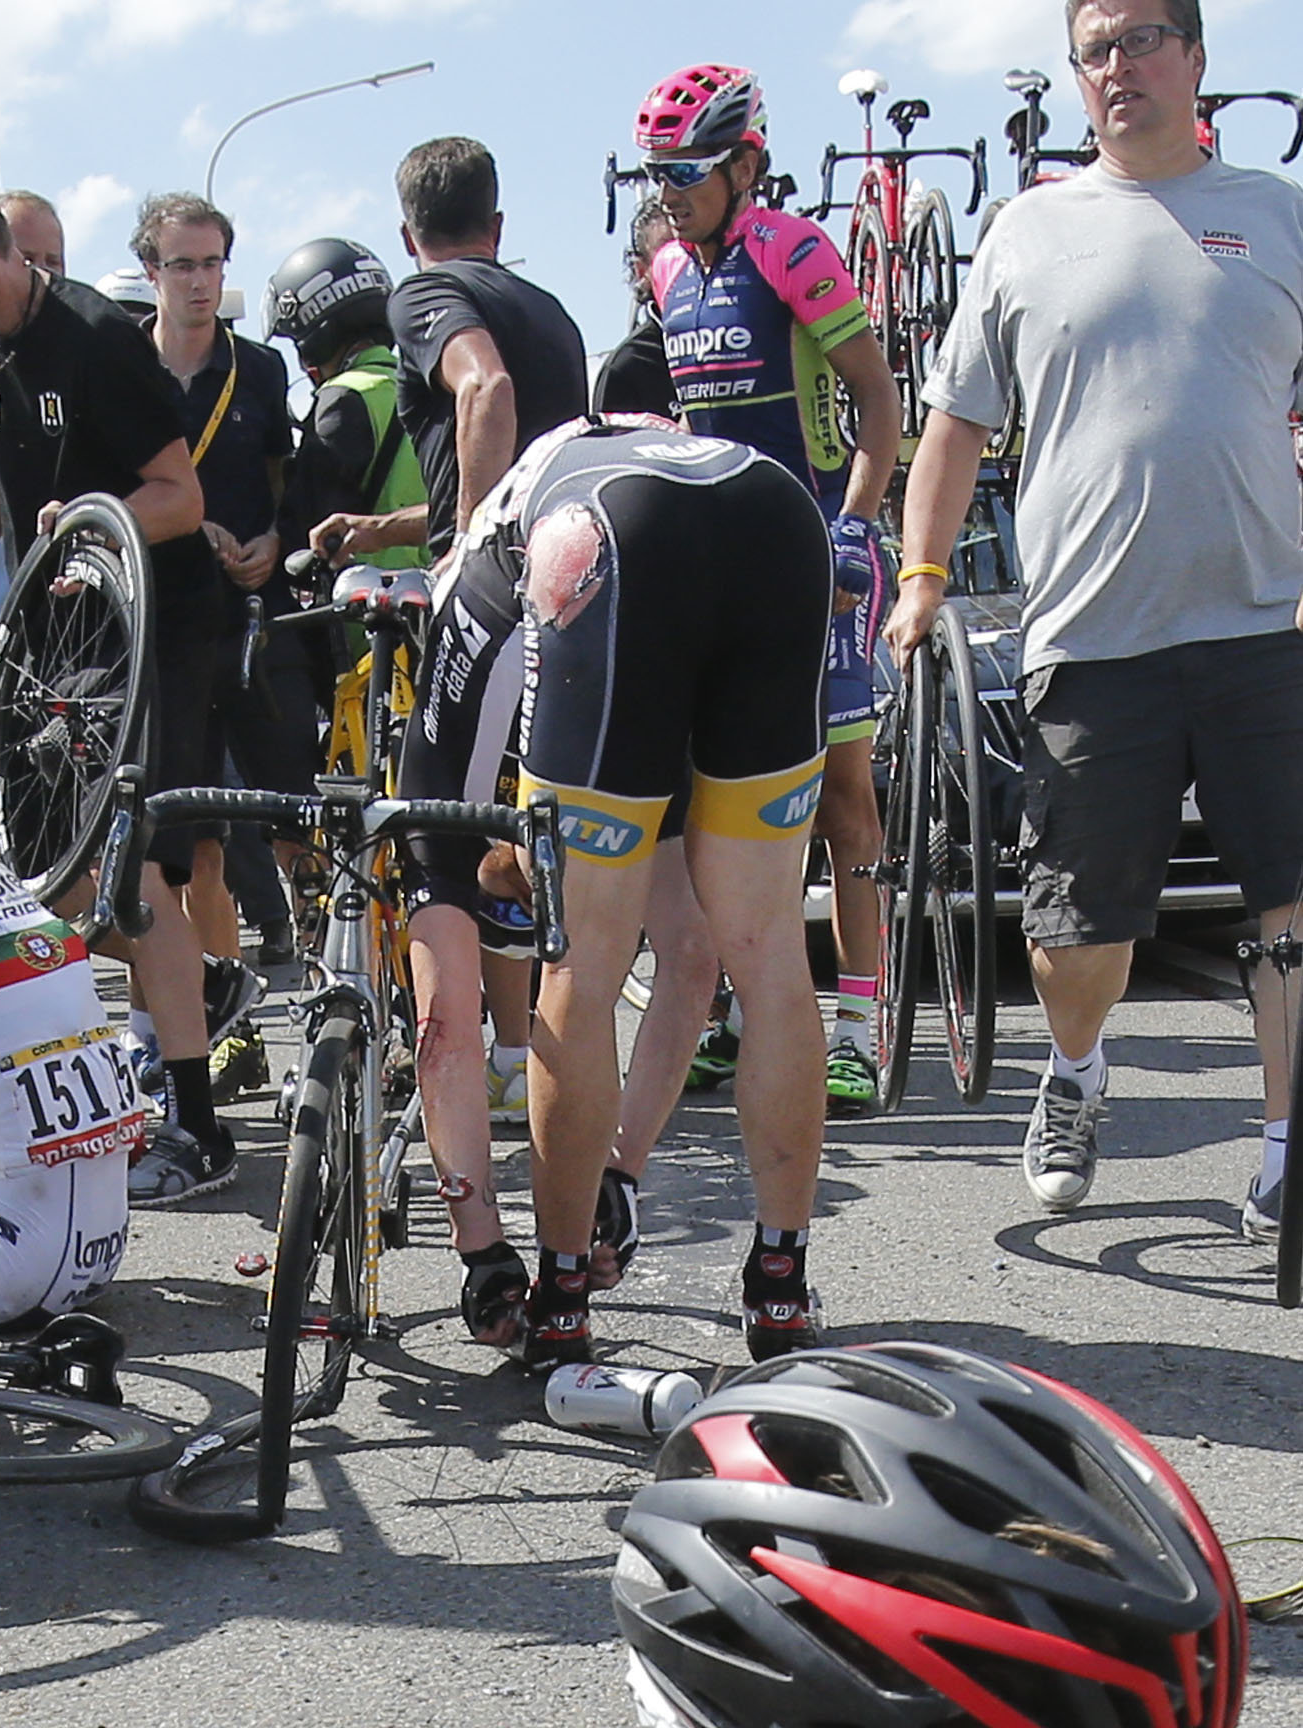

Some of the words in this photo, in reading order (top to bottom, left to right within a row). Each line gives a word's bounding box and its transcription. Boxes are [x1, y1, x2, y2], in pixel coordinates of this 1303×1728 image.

[422, 625, 455, 744] dimension
[445, 653, 473, 703] data
[16, 1054, 111, 1140] 151
